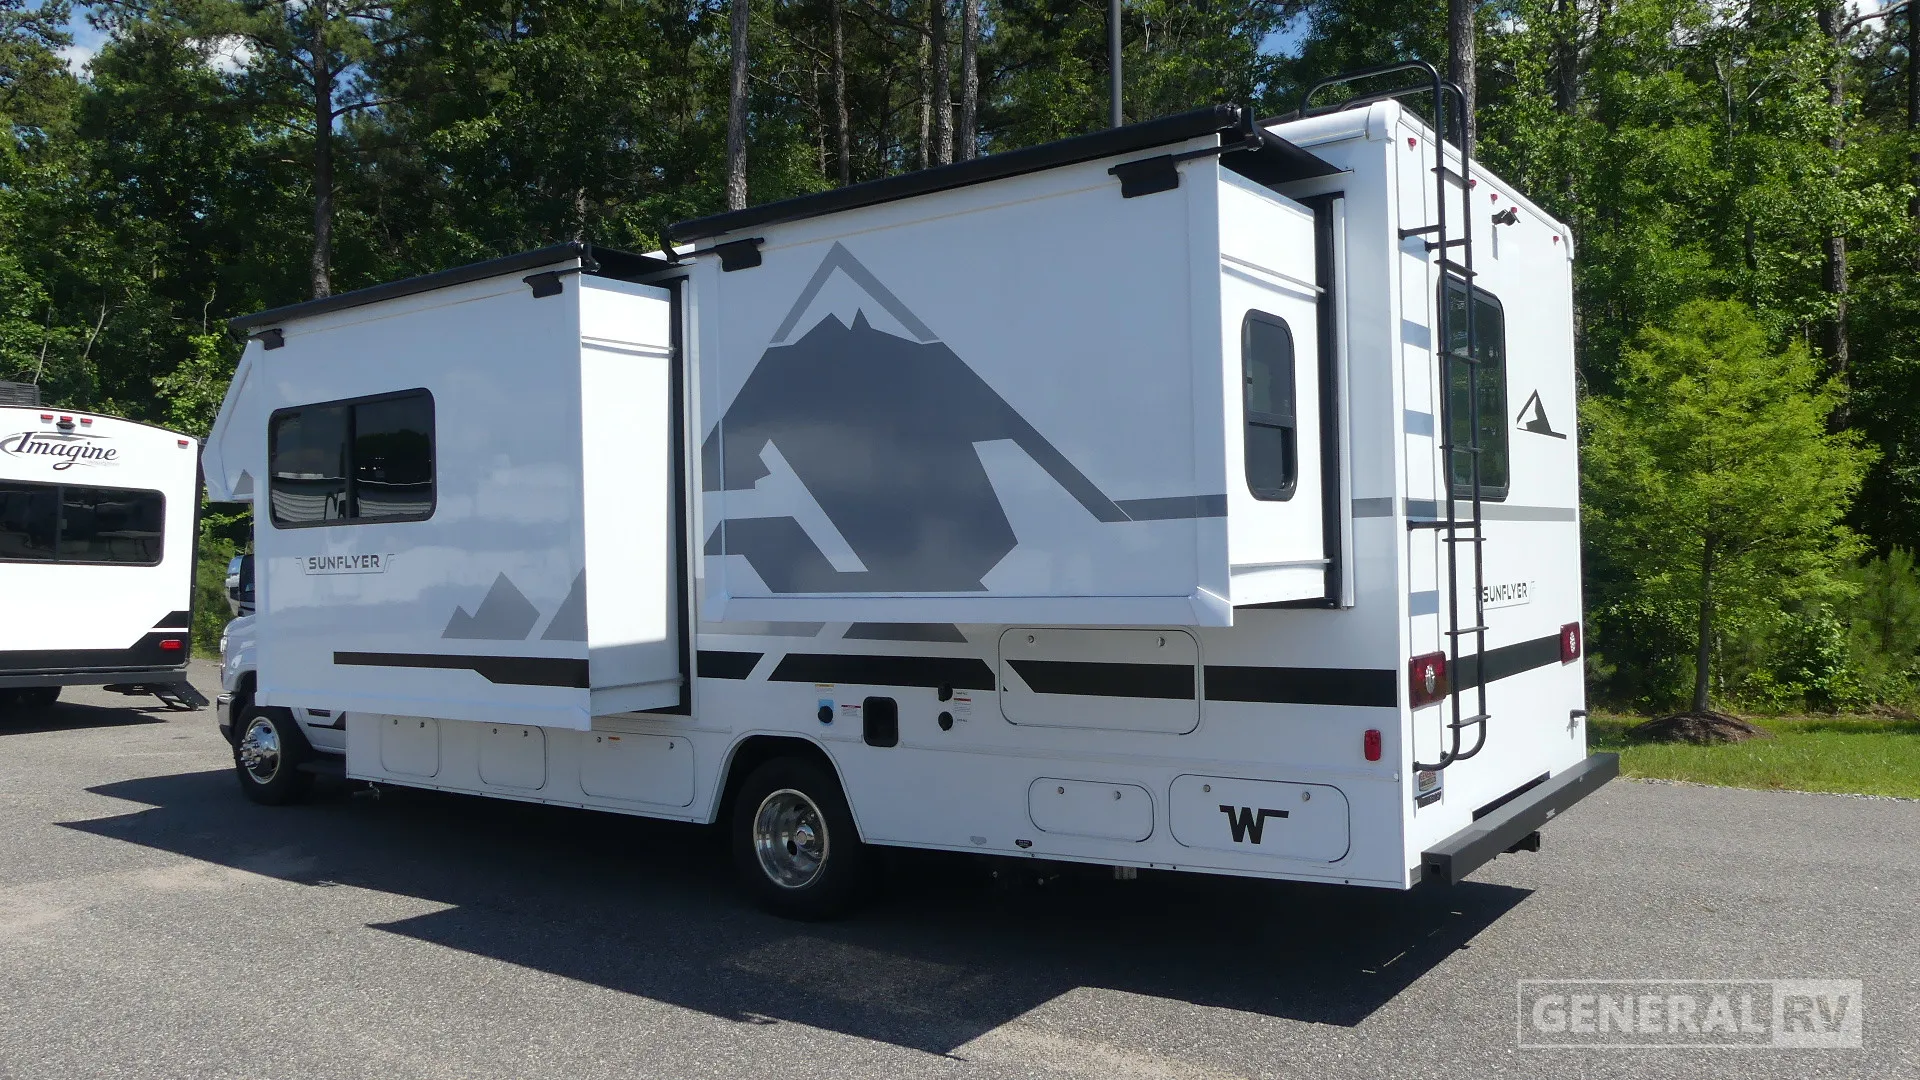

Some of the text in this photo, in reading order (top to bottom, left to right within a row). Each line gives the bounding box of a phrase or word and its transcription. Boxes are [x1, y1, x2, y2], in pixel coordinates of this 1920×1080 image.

[11, 431, 119, 470] Imagine
[309, 555, 380, 570] SUNFLYER
[1482, 582, 1528, 603] SUNFLYER
